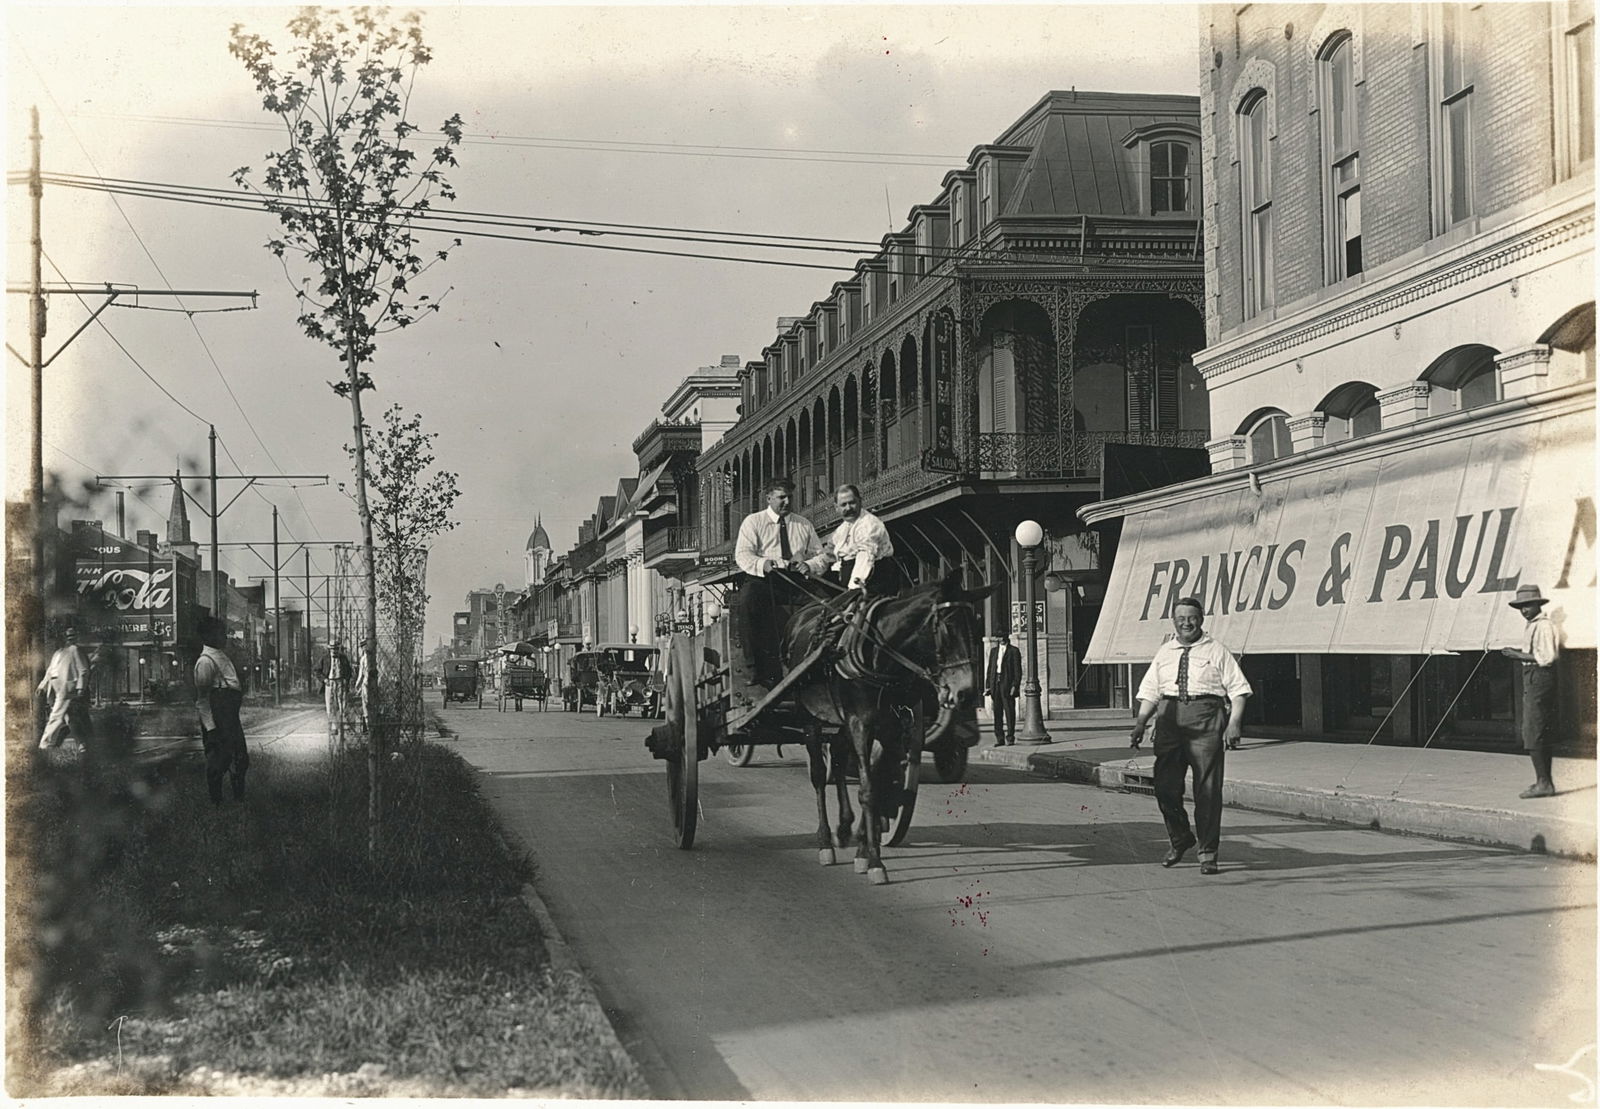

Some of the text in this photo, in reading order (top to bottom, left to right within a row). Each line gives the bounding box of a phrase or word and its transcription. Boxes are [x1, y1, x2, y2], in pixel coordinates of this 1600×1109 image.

[931, 456, 958, 470] SALOON
[1140, 540, 1306, 621] FRANCIS
[1316, 532, 1352, 607] &
[1367, 507, 1523, 604] PAUL
